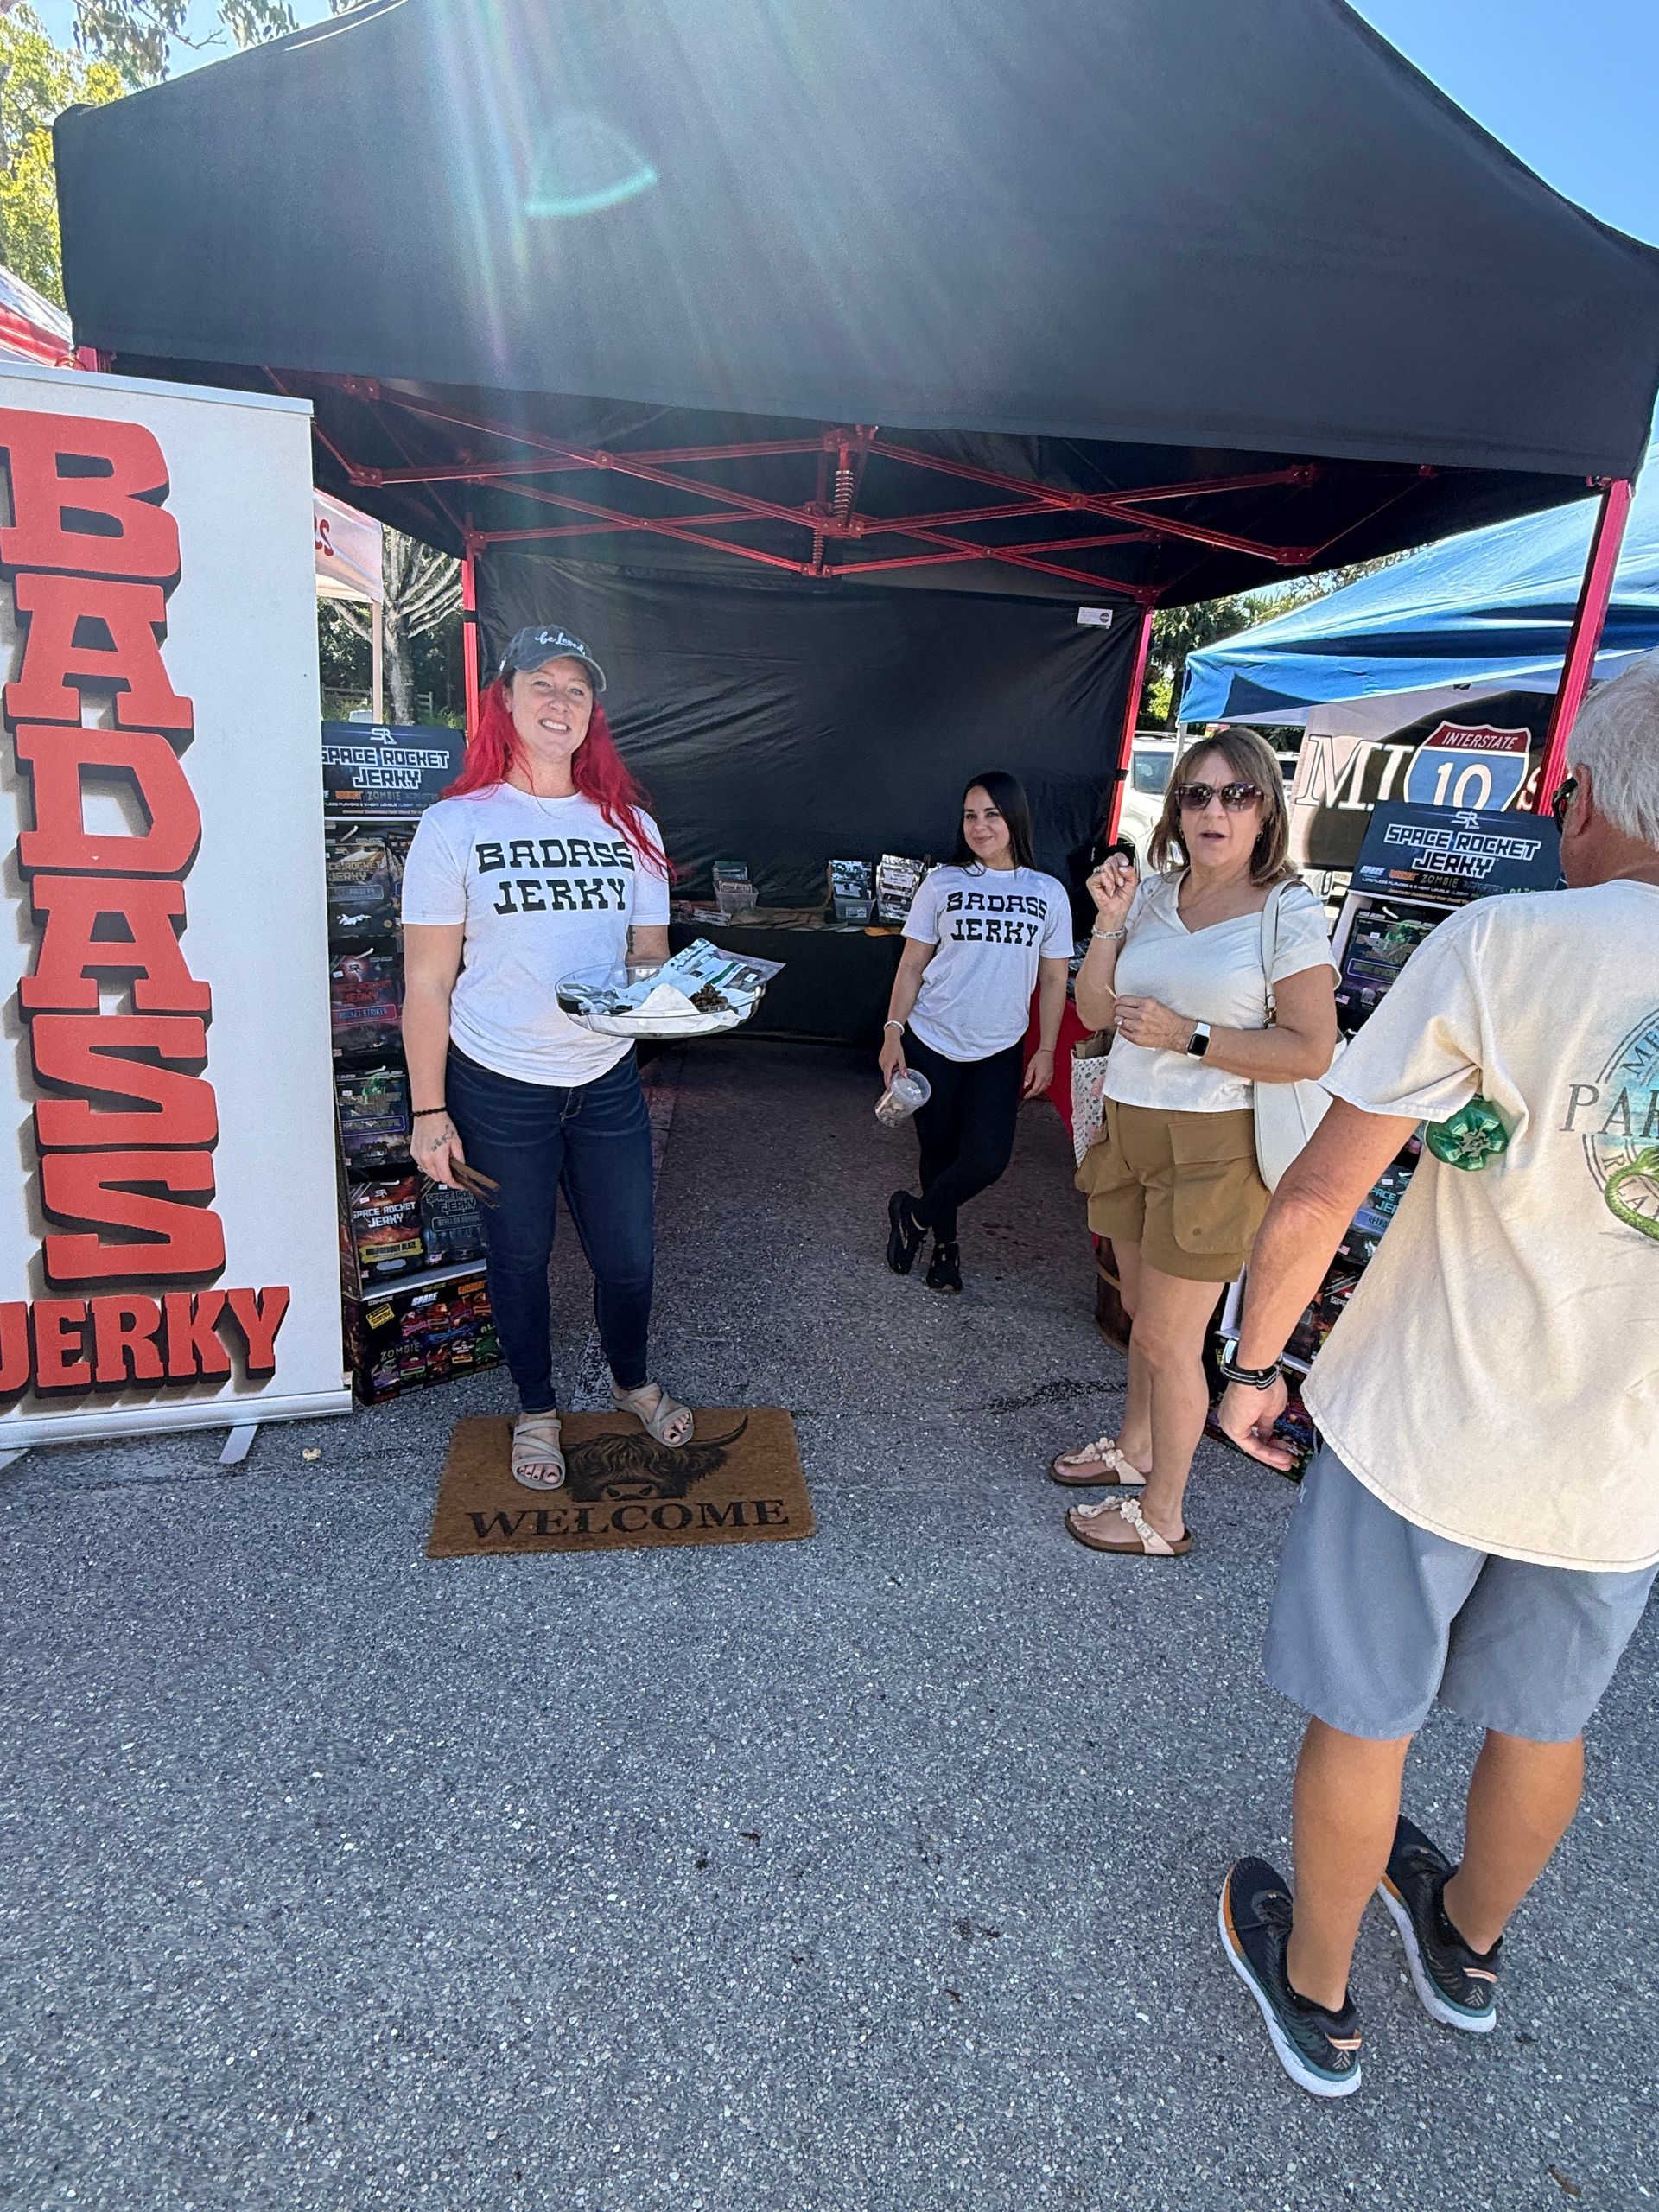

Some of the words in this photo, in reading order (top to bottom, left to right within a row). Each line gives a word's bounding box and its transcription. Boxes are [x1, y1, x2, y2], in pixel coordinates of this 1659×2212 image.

[1441, 730, 1519, 752] INTERSTATE
[380, 747, 449, 769] ROCKET
[352, 766, 422, 789] JERKY
[1433, 761, 1491, 810] 10
[0, 407, 225, 1288] BADASS
[475, 838, 635, 874] BADASS
[1383, 823, 1453, 849] SPACE
[1454, 832, 1542, 861] ROCKET
[1411, 849, 1496, 880] JERKY
[493, 878, 626, 915] JERKY
[1420, 874, 1460, 889] ZOMBIE
[946, 891, 1048, 922] BADASS
[950, 918, 1039, 947] JERKY
[352, 1207, 381, 1220] SPACE
[383, 1201, 416, 1215] ROCKET
[426, 1192, 455, 1204] SPACE
[441, 1198, 477, 1213] JERKY
[367, 1212, 404, 1228] JERKY
[0, 1286, 289, 1402] JERKY
[467, 1499, 789, 1539] WELCOME
